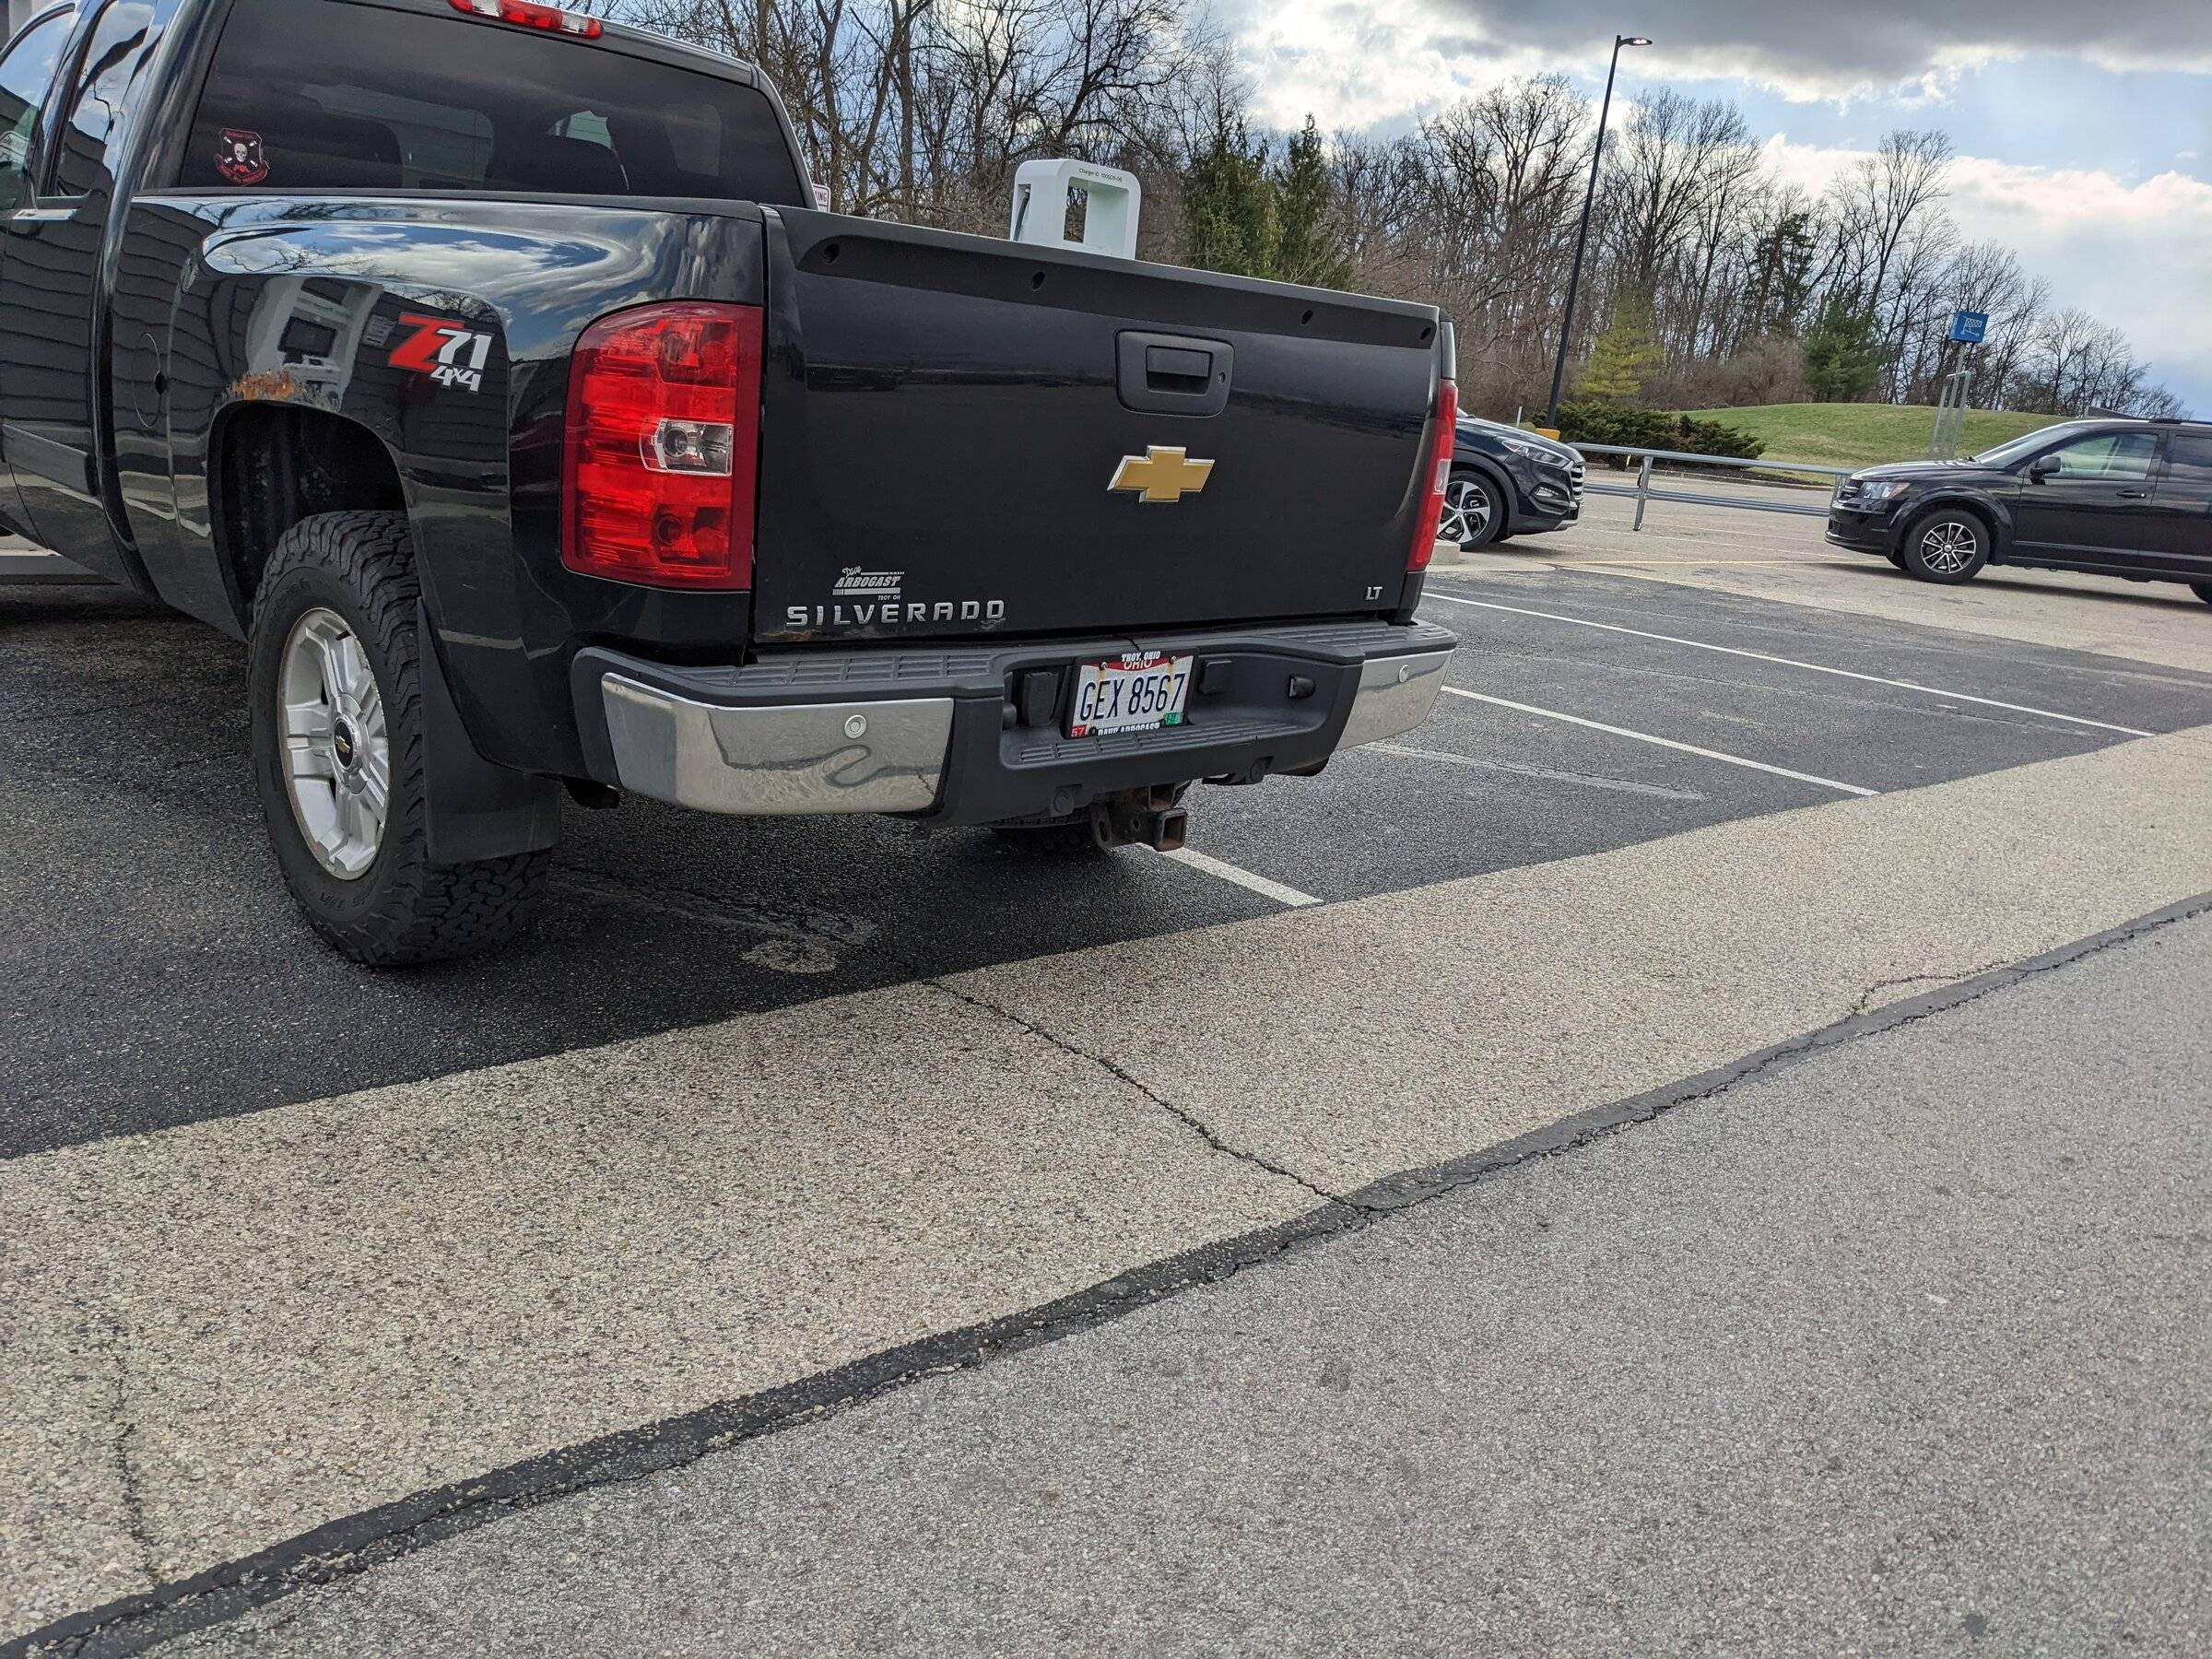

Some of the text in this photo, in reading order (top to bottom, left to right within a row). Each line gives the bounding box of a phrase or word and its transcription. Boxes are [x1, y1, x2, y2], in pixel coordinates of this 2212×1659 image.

[389, 312, 492, 374] Z71
[834, 575, 901, 588] ARBOGAST
[1365, 586, 1382, 600] LT
[786, 600, 1005, 627] SILVERADO
[1143, 651, 1161, 660] OHIO
[1080, 673, 1186, 722] GEX 8567
[1070, 726, 1086, 737] 57
